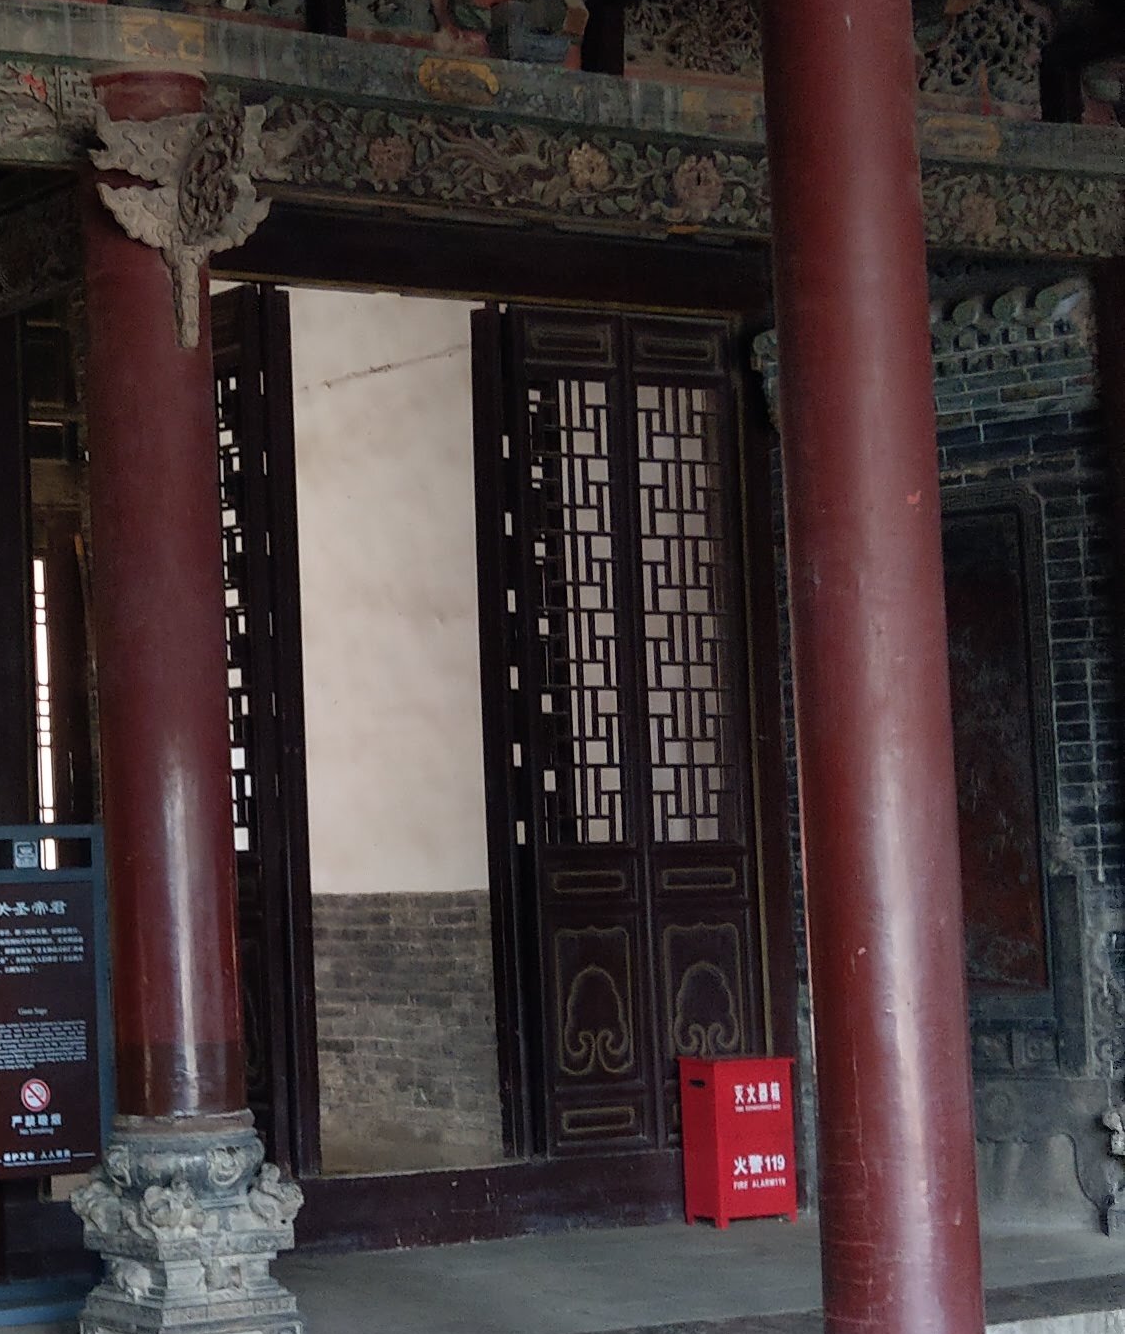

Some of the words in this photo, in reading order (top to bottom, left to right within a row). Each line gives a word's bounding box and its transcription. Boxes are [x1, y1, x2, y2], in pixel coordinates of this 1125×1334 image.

[734, 1081, 781, 1105] 灭火器箱
[733, 1154, 785, 1176] 火警119
[733, 1179, 748, 1190] FIRE
